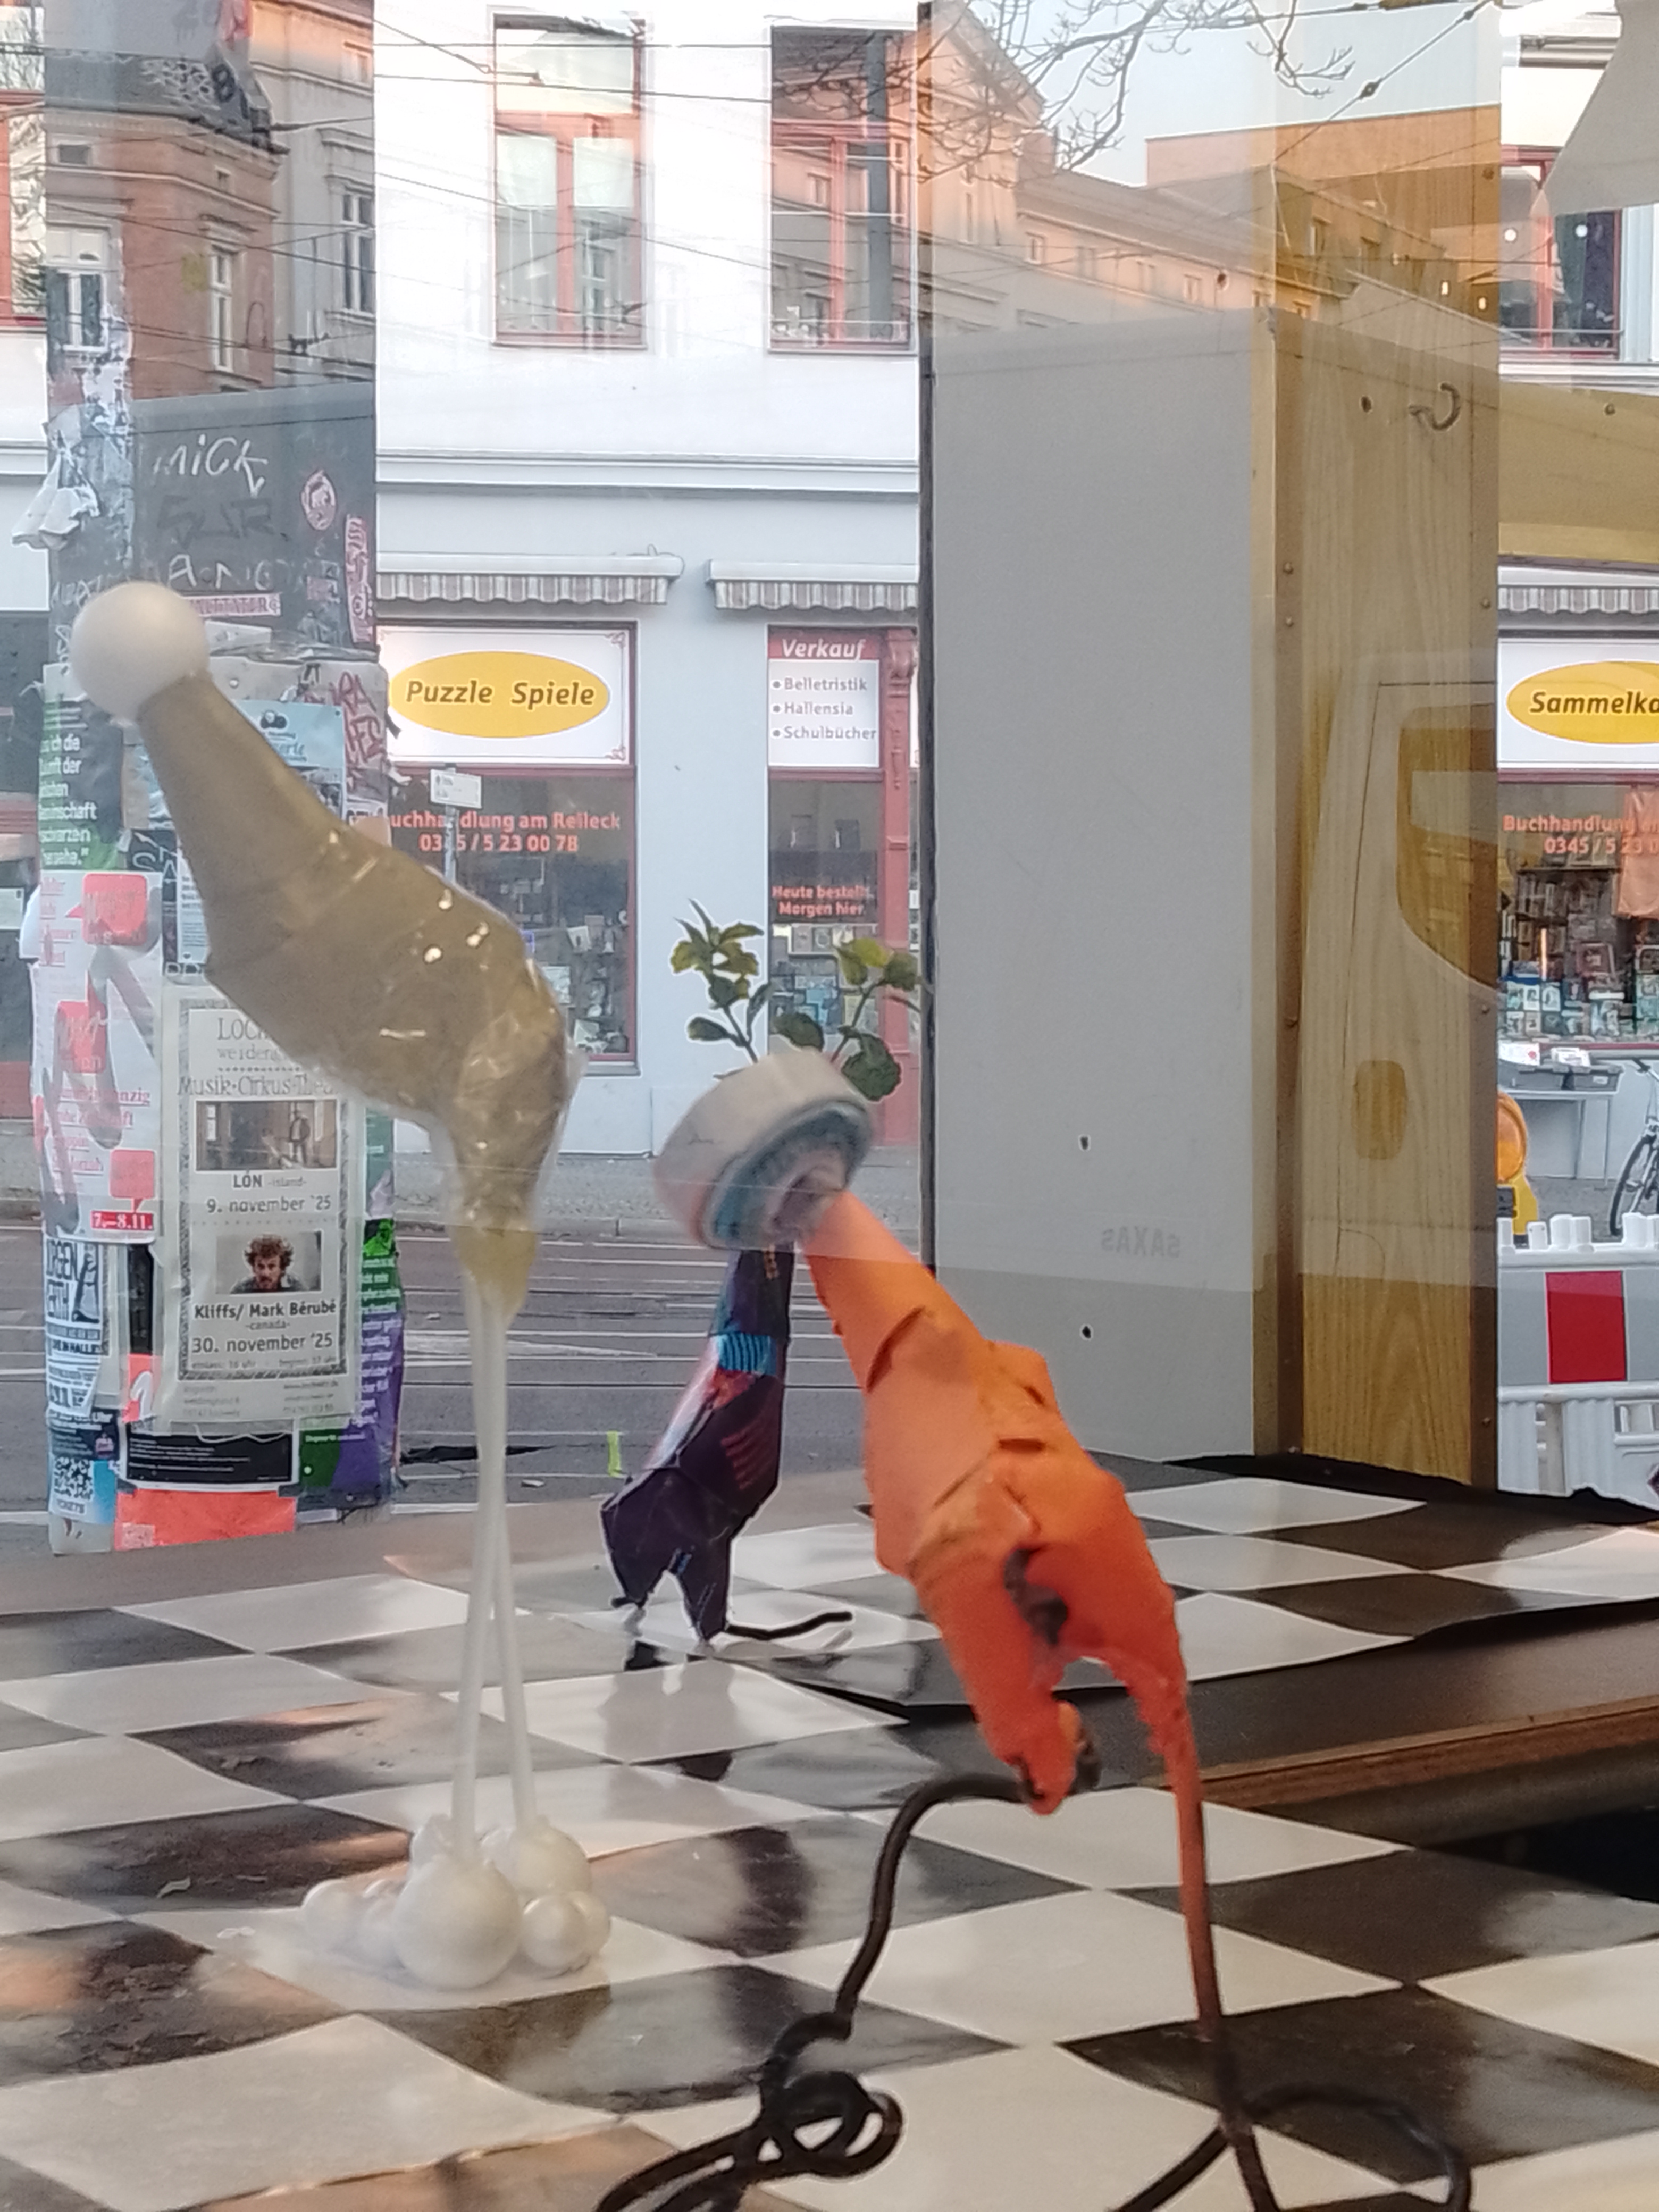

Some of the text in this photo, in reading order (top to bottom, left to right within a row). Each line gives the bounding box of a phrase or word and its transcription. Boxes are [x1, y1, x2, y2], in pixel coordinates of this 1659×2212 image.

[781, 638, 866, 661] Verkauf
[784, 677, 868, 691] Belletristik
[406, 680, 595, 710] Puzzle Spiele
[1529, 691, 1659, 714] Sammelka
[784, 702, 853, 715] Hallensia
[784, 725, 877, 740] Schulbücher
[518, 814, 548, 829] am
[1502, 814, 1636, 837] Buchhandlung
[419, 834, 467, 851] 035
[483, 834, 493, 851] 5
[499, 834, 522, 851] 23
[526, 834, 550, 852] 00
[556, 834, 578, 852] 78
[1543, 836, 1589, 854] 0345
[1605, 837, 1616, 854] 5
[778, 901, 833, 918] Morgen
[206, 1197, 223, 1213] 9.
[229, 1196, 305, 1213] november
[249, 1302, 285, 1318] Mark
[191, 1337, 219, 1353] 30.
[226, 1334, 306, 1353] november
